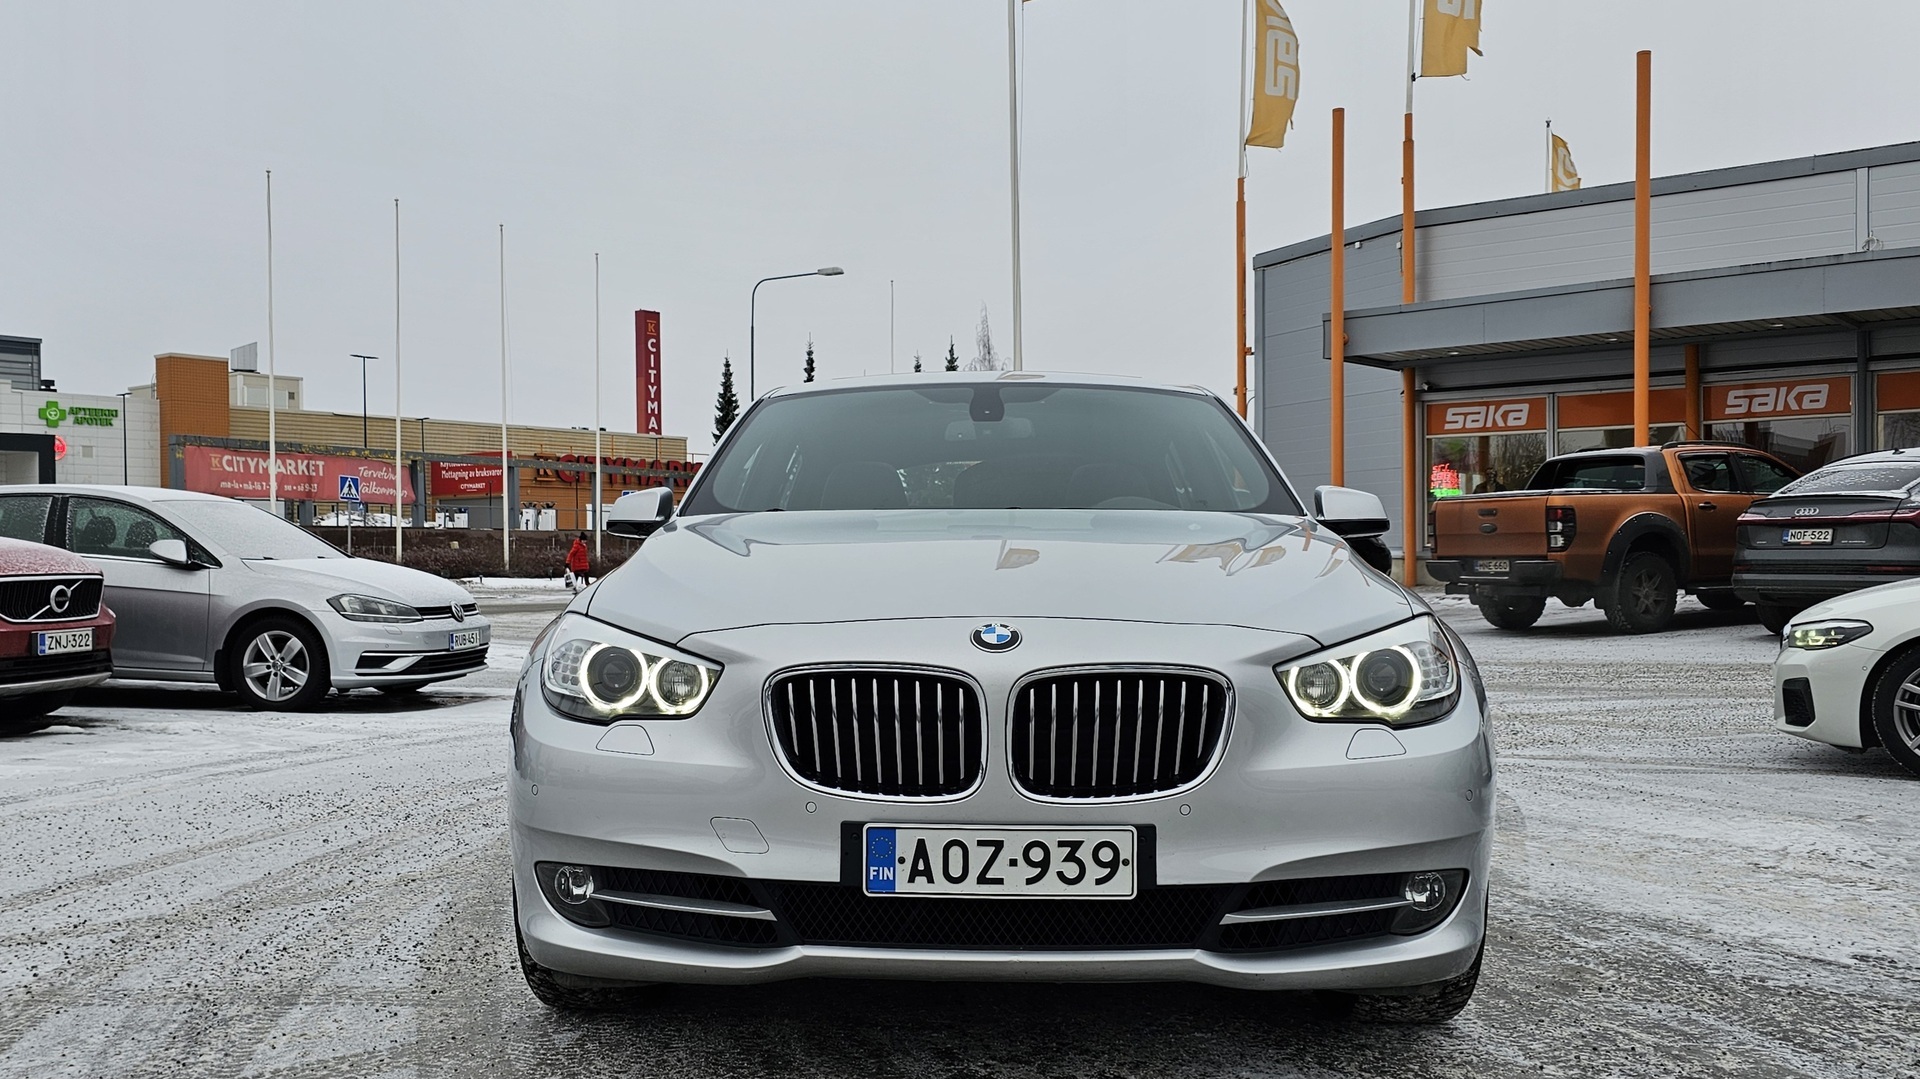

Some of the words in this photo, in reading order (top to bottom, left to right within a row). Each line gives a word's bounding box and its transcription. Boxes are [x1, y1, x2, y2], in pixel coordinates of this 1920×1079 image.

[648, 338, 659, 435] CITYMA
[73, 416, 114, 427] APOTEK
[222, 455, 325, 477] CITYMARKET
[441, 469, 468, 480] Mottagning
[475, 467, 503, 477] bruksvaror
[360, 481, 408, 498] älkommn
[1790, 531, 1830, 541] NOF-522
[48, 633, 90, 650] ZNJ-322
[869, 866, 894, 881] FIN
[907, 838, 1121, 886] AOZ-939
